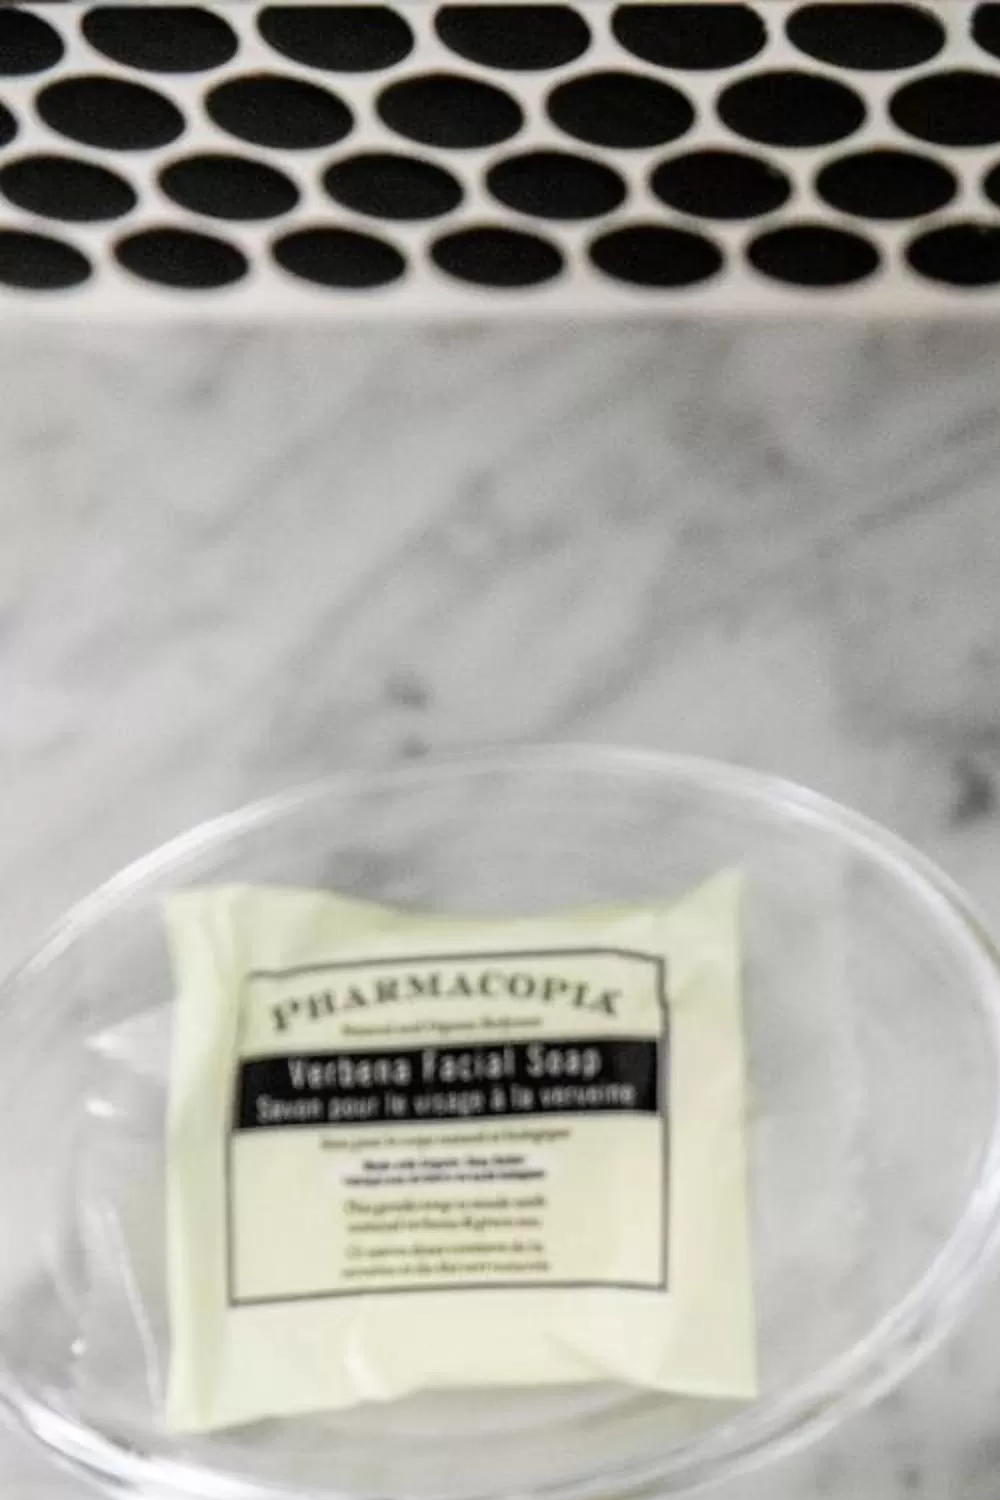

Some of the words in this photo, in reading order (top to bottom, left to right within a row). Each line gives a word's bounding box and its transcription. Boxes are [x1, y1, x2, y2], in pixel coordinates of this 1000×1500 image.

[271, 968, 622, 1032] PHARMACOPIA
[288, 1055, 411, 1089] Verbena
[422, 1048, 515, 1083] Facial
[527, 1043, 601, 1079] Soap
